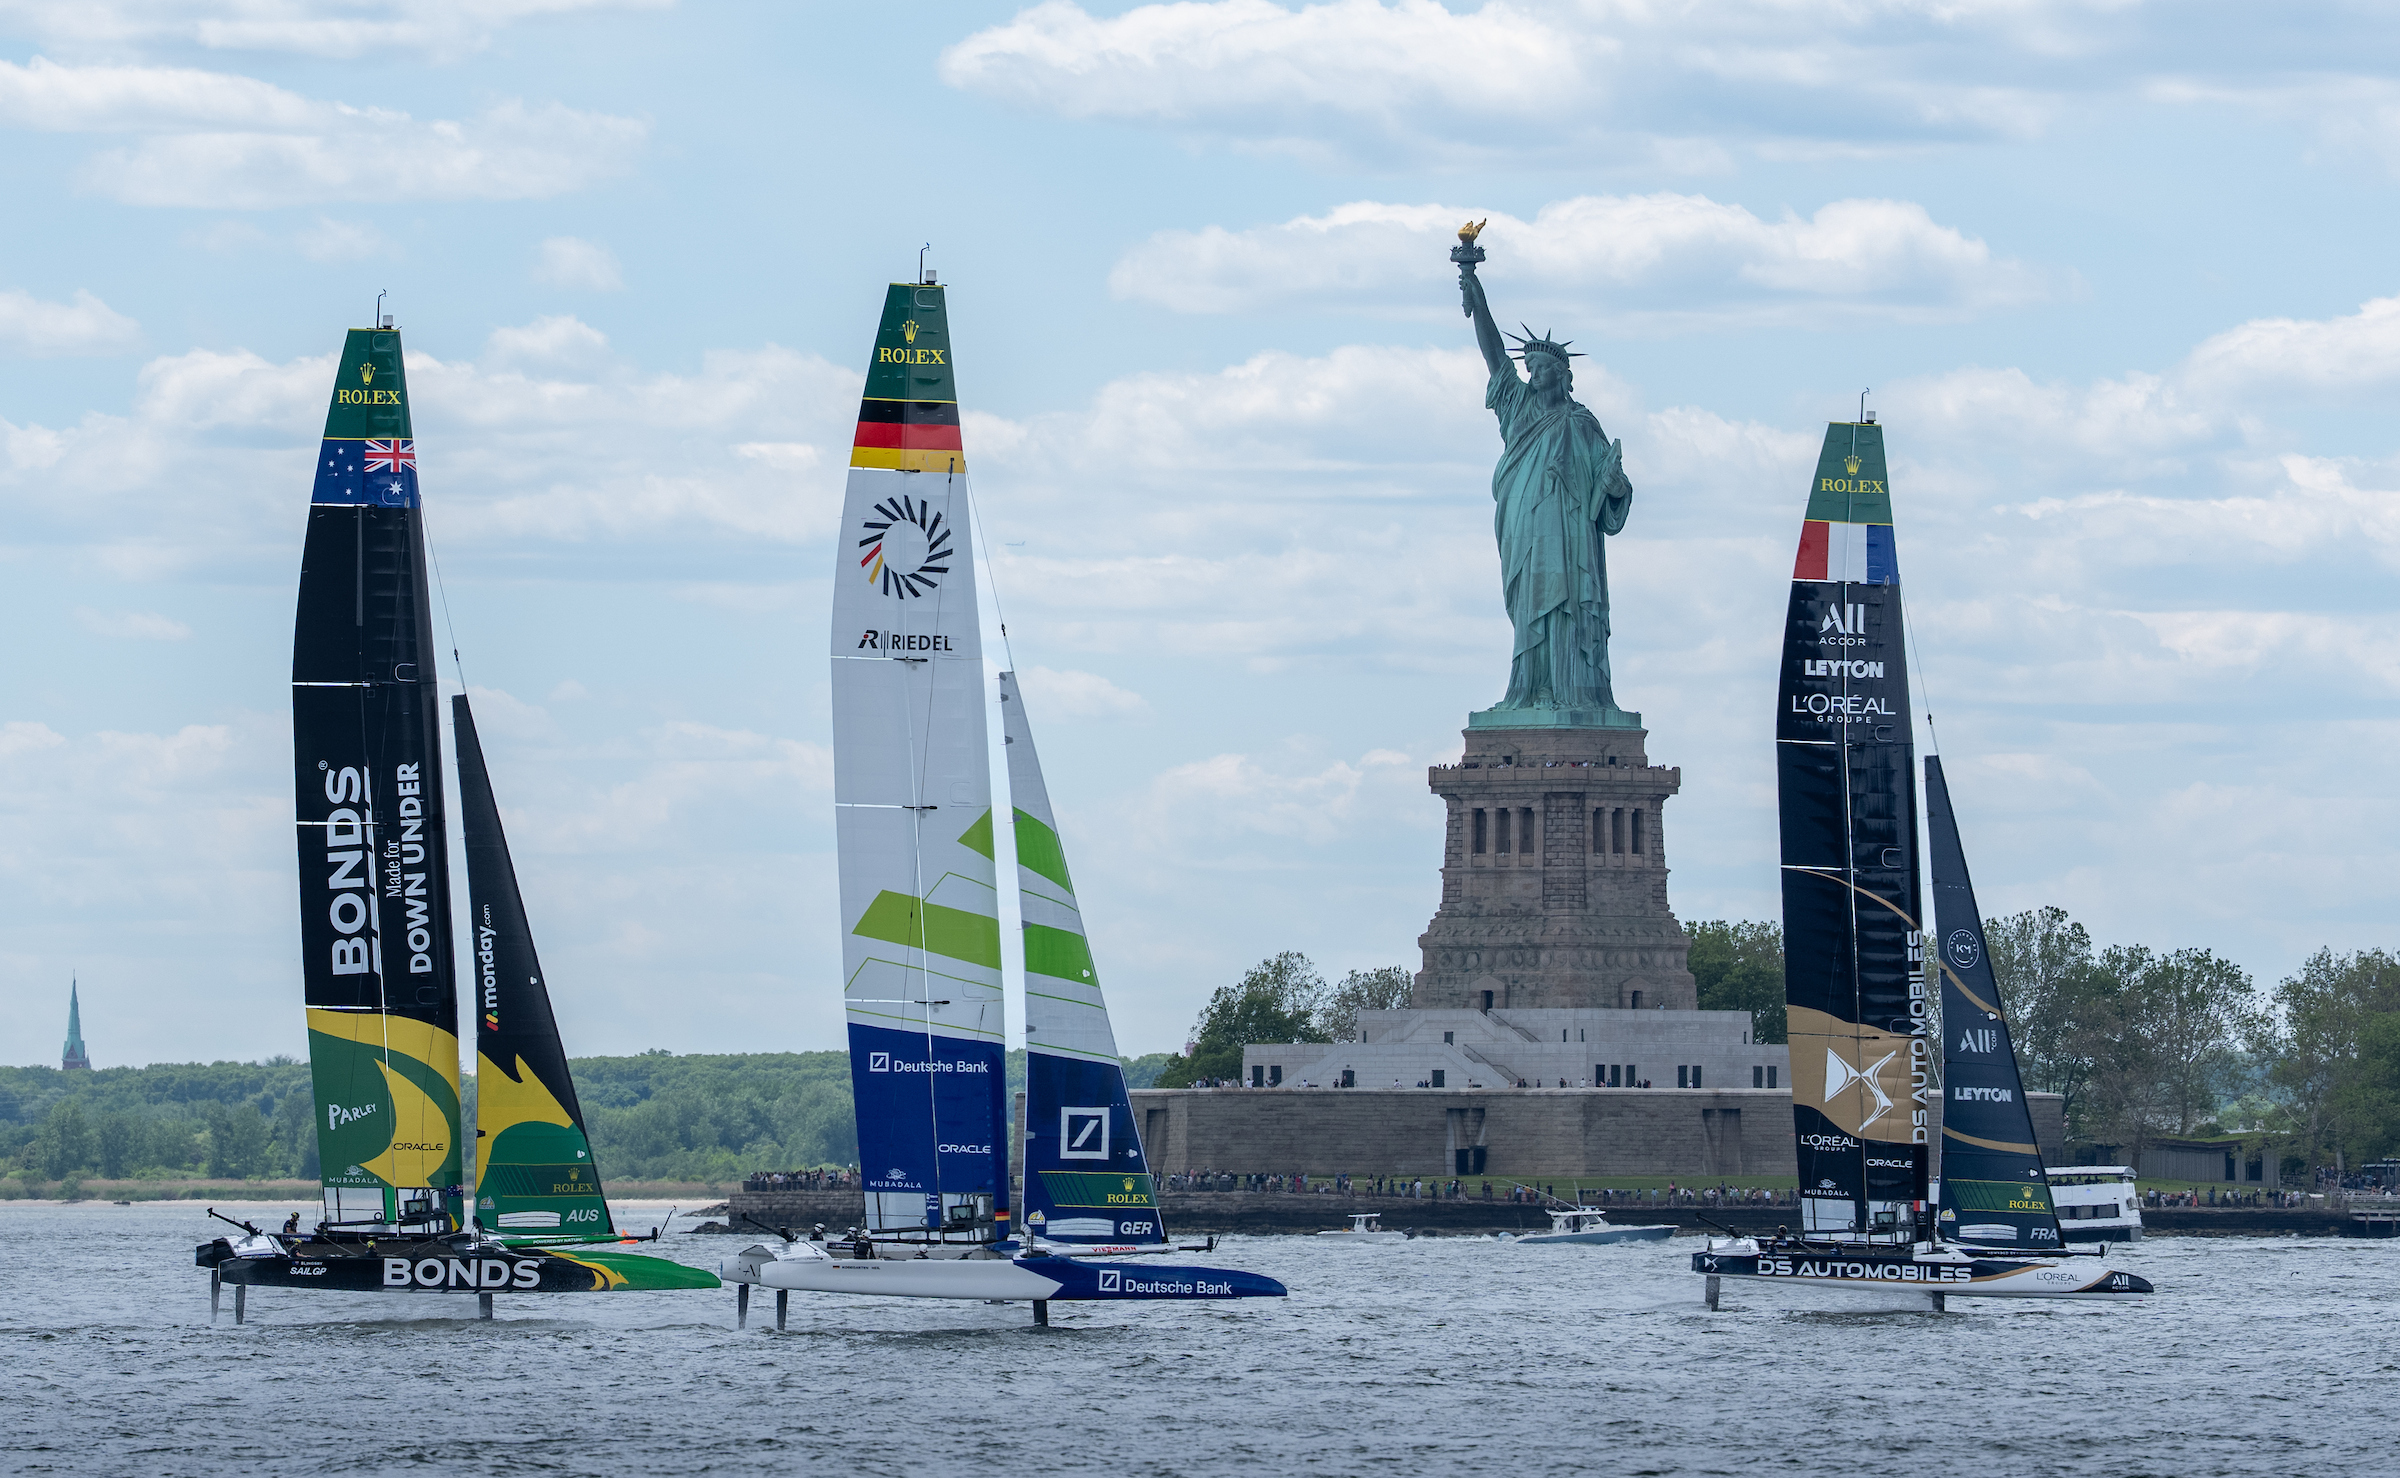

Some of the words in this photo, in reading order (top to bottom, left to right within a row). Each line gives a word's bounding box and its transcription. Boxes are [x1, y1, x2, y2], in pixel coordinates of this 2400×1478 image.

[878, 347, 946, 365] ROLEX
[338, 389, 401, 405] ROLEX
[1820, 478, 1885, 494] ROLEX
[891, 634, 953, 651] RIEDEL
[1818, 636, 1866, 647] ACCOR
[1804, 659, 1884, 679] LEYTON
[1792, 693, 1896, 715] L'ORÉAL
[1816, 715, 1872, 724] GROUPE
[397, 761, 426, 865] UNDER
[383, 839, 400, 860] for
[385, 861, 402, 899] Made
[404, 872, 433, 974] DOWN
[478, 903, 498, 1009] monday.com
[1906, 929, 1928, 1105] AUTOMOBILES
[893, 1059, 954, 1073] Deutsche
[956, 1060, 989, 1074] Bank
[1954, 1087, 2013, 1103] LEYTON
[328, 1101, 377, 1131] PARLEY
[1912, 1108, 1928, 1144] DS
[393, 1141, 444, 1151] ORACLE
[938, 1143, 991, 1154] ORACLE
[1800, 1134, 1860, 1148] L'ORÉAL
[1866, 1158, 1913, 1169] ORACLE
[328, 1176, 379, 1185] MUBADALA
[552, 1183, 594, 1193] ROLEX
[869, 1180, 922, 1189] MUBADALA
[1107, 1193, 1149, 1204] ROLEX
[1804, 1188, 1849, 1197] MUBADALA
[2008, 1199, 2046, 1210] ROLEX
[565, 1209, 599, 1223] AUS
[1120, 1221, 1153, 1235] GER
[2030, 1227, 2058, 1240] FRA
[289, 1266, 327, 1276] SAILGP
[1757, 1259, 1793, 1276] DS
[1796, 1261, 1972, 1283] AUTOMOBILES
[1125, 1278, 1193, 1294] Deutsche
[1196, 1280, 1233, 1296] Bank
